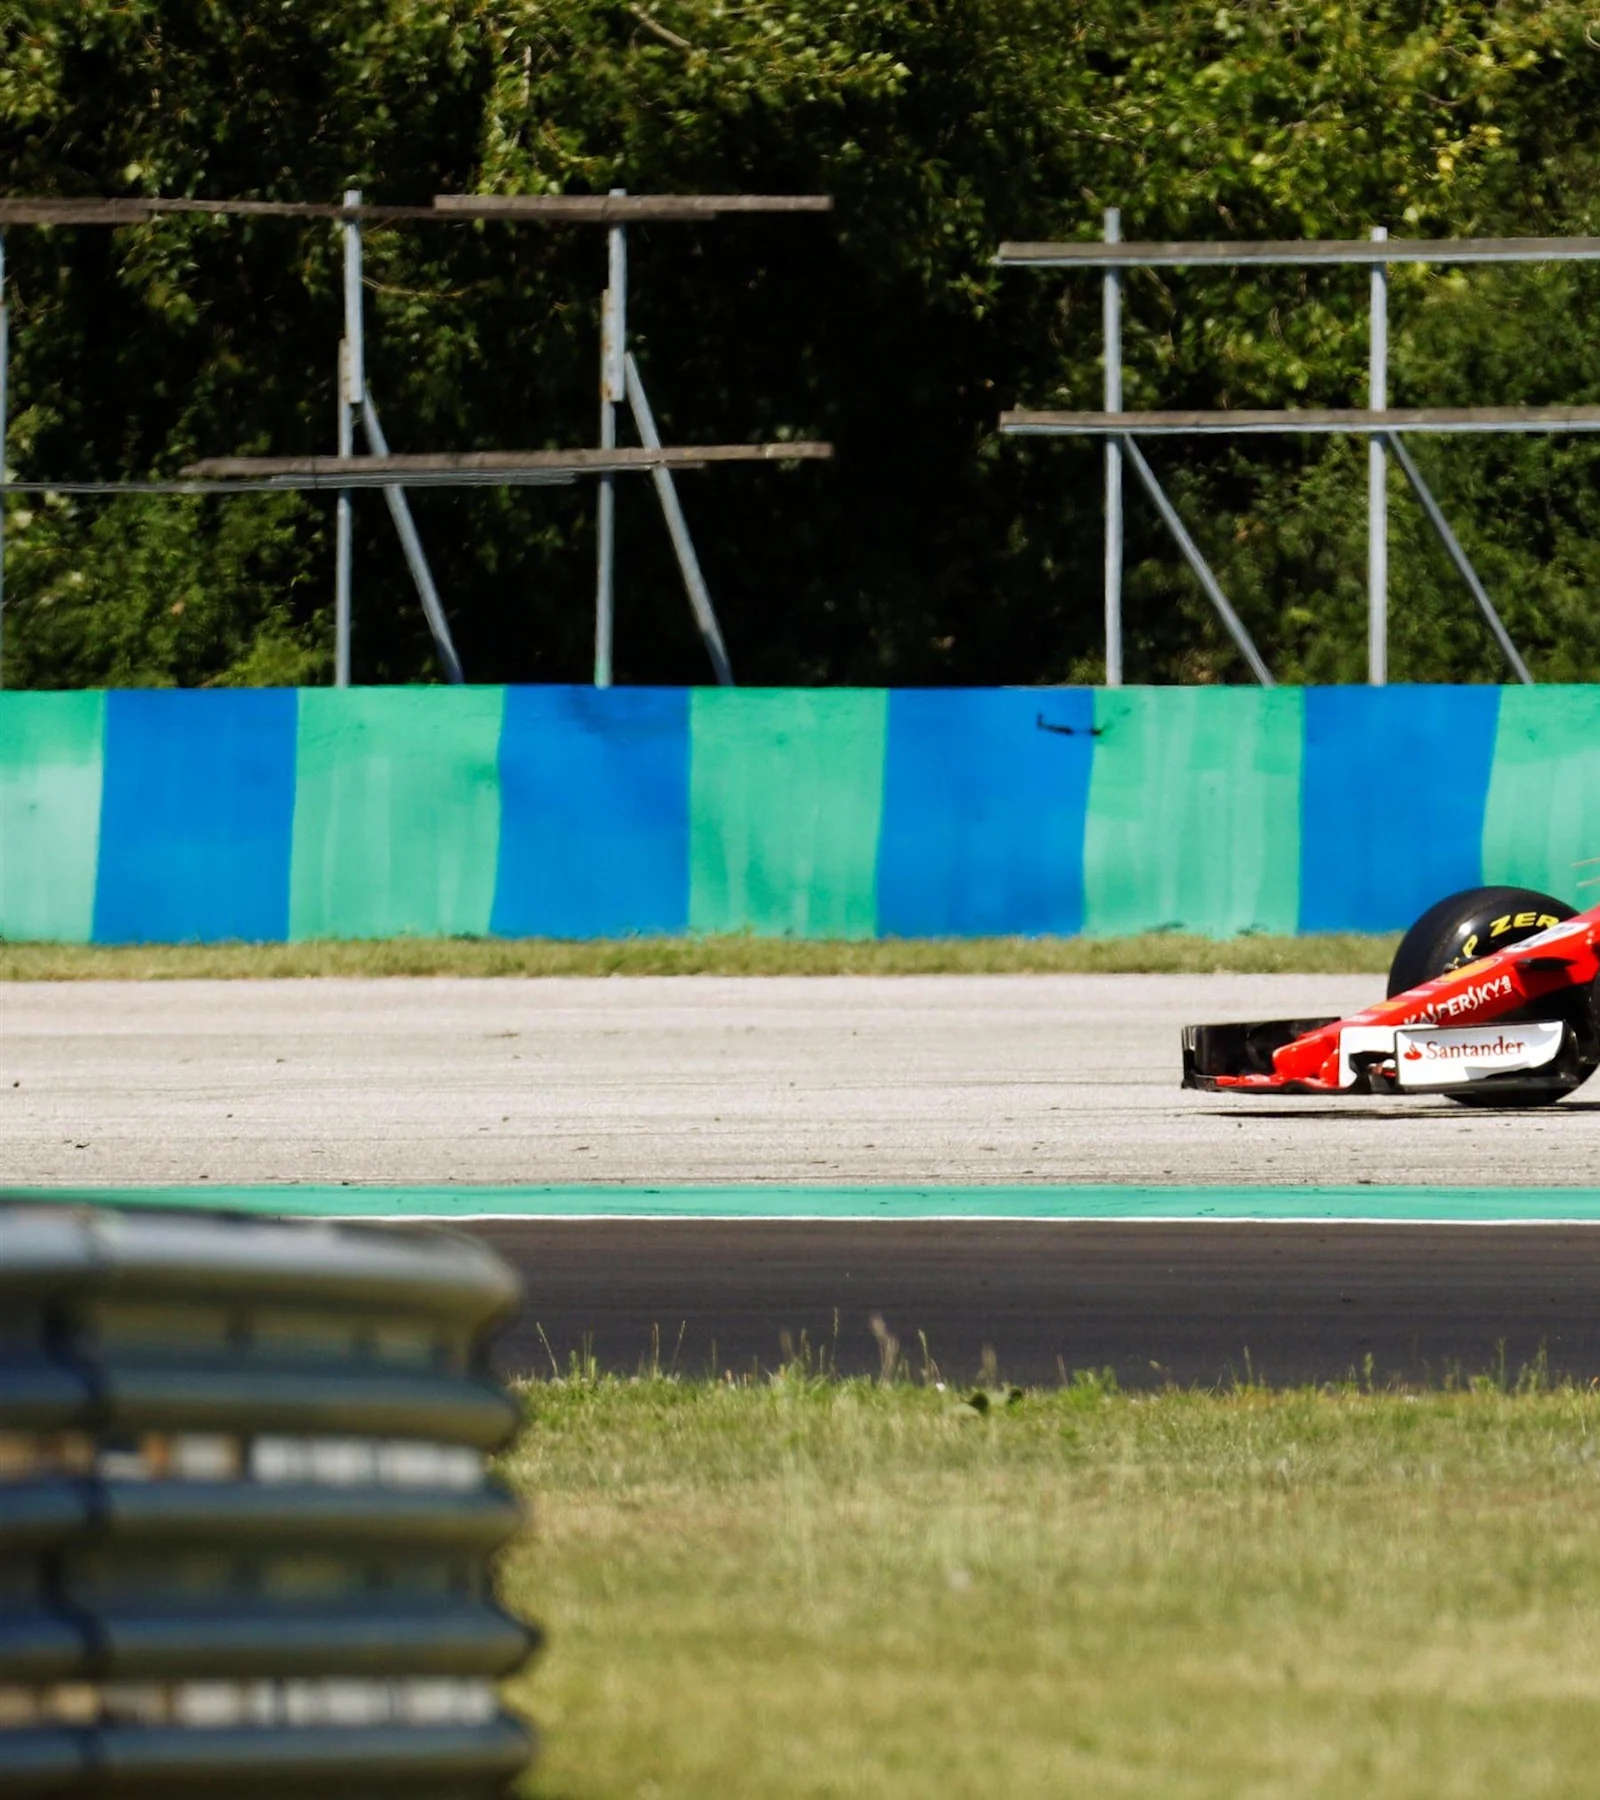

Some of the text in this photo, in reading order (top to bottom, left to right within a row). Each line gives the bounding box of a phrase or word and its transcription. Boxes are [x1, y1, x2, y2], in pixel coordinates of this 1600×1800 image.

[1490, 912, 1560, 938] ZER
[1403, 978, 1501, 1025] KASPERSKY
[1426, 1036, 1525, 1060] Santander
